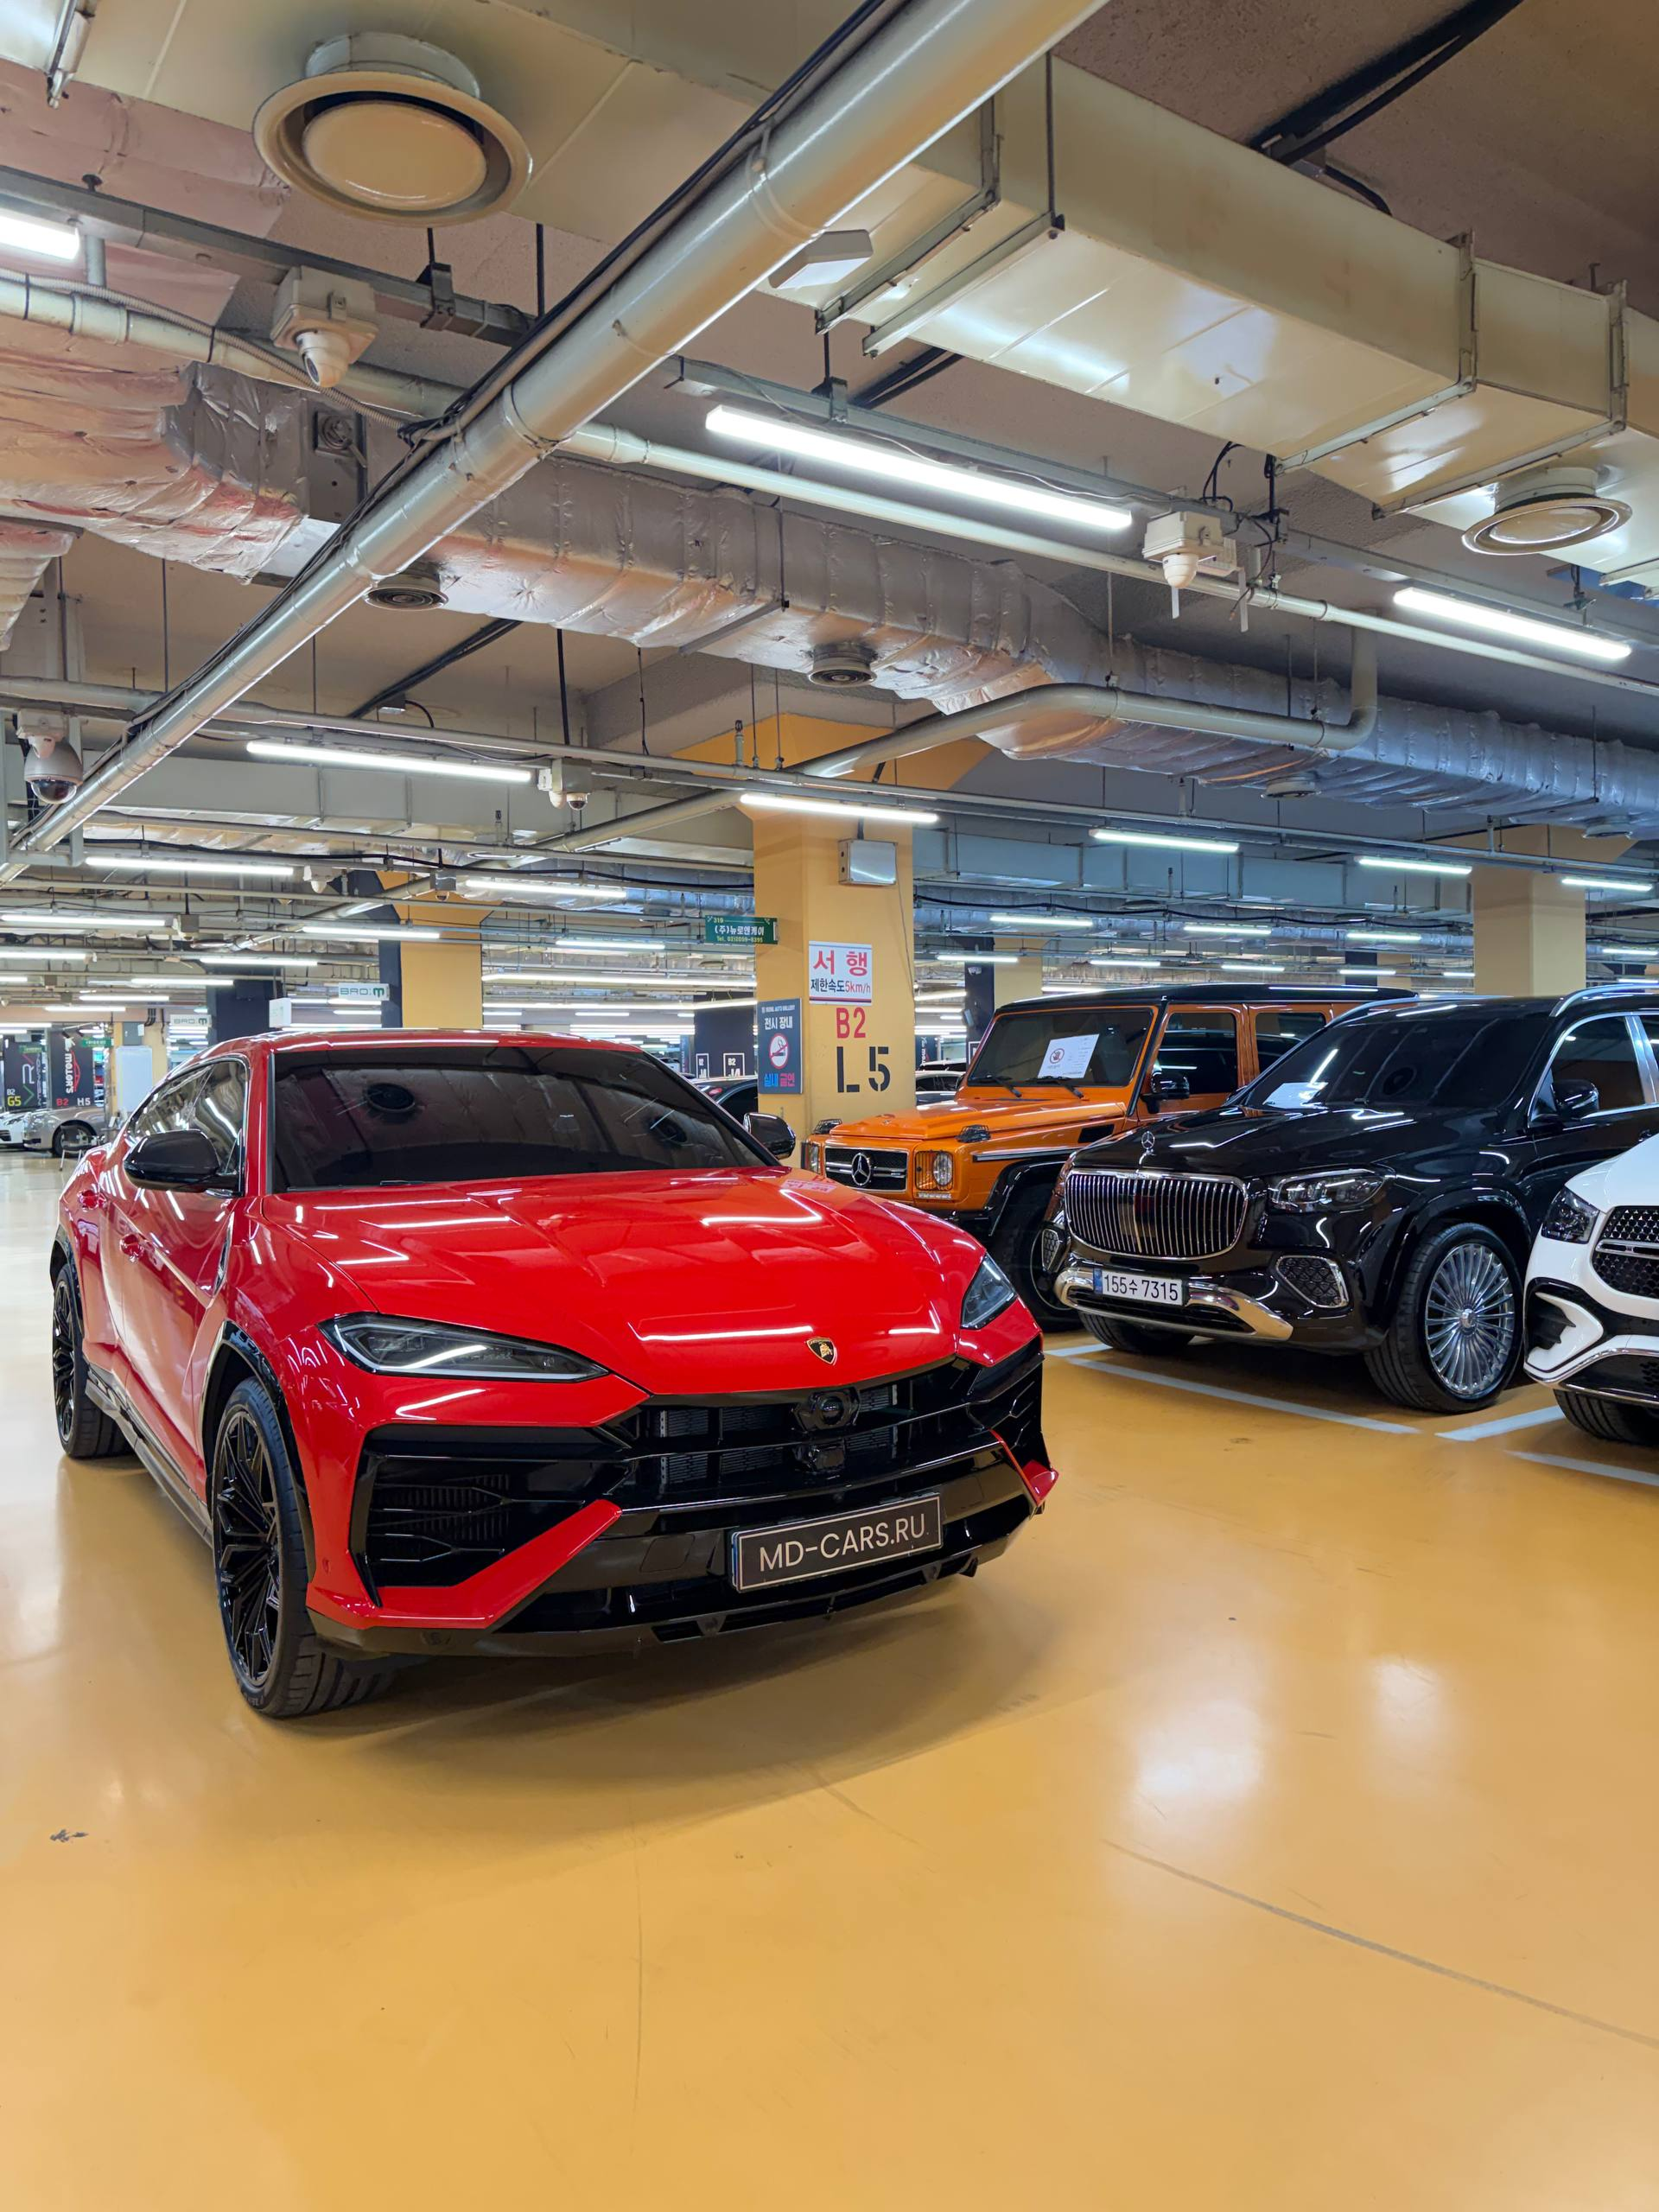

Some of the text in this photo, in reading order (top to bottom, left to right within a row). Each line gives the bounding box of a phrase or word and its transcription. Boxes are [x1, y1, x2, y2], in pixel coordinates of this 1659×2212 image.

[764, 1015, 793, 1030] 전시 장내
[836, 1007, 868, 1039] B2
[728, 1058, 736, 1066] B2
[7, 1096, 22, 1107] G5
[77, 1097, 91, 1106] H5
[1103, 1274, 1179, 1301] 155수 7315
[759, 1512, 926, 1573] MD-CARS.RU
